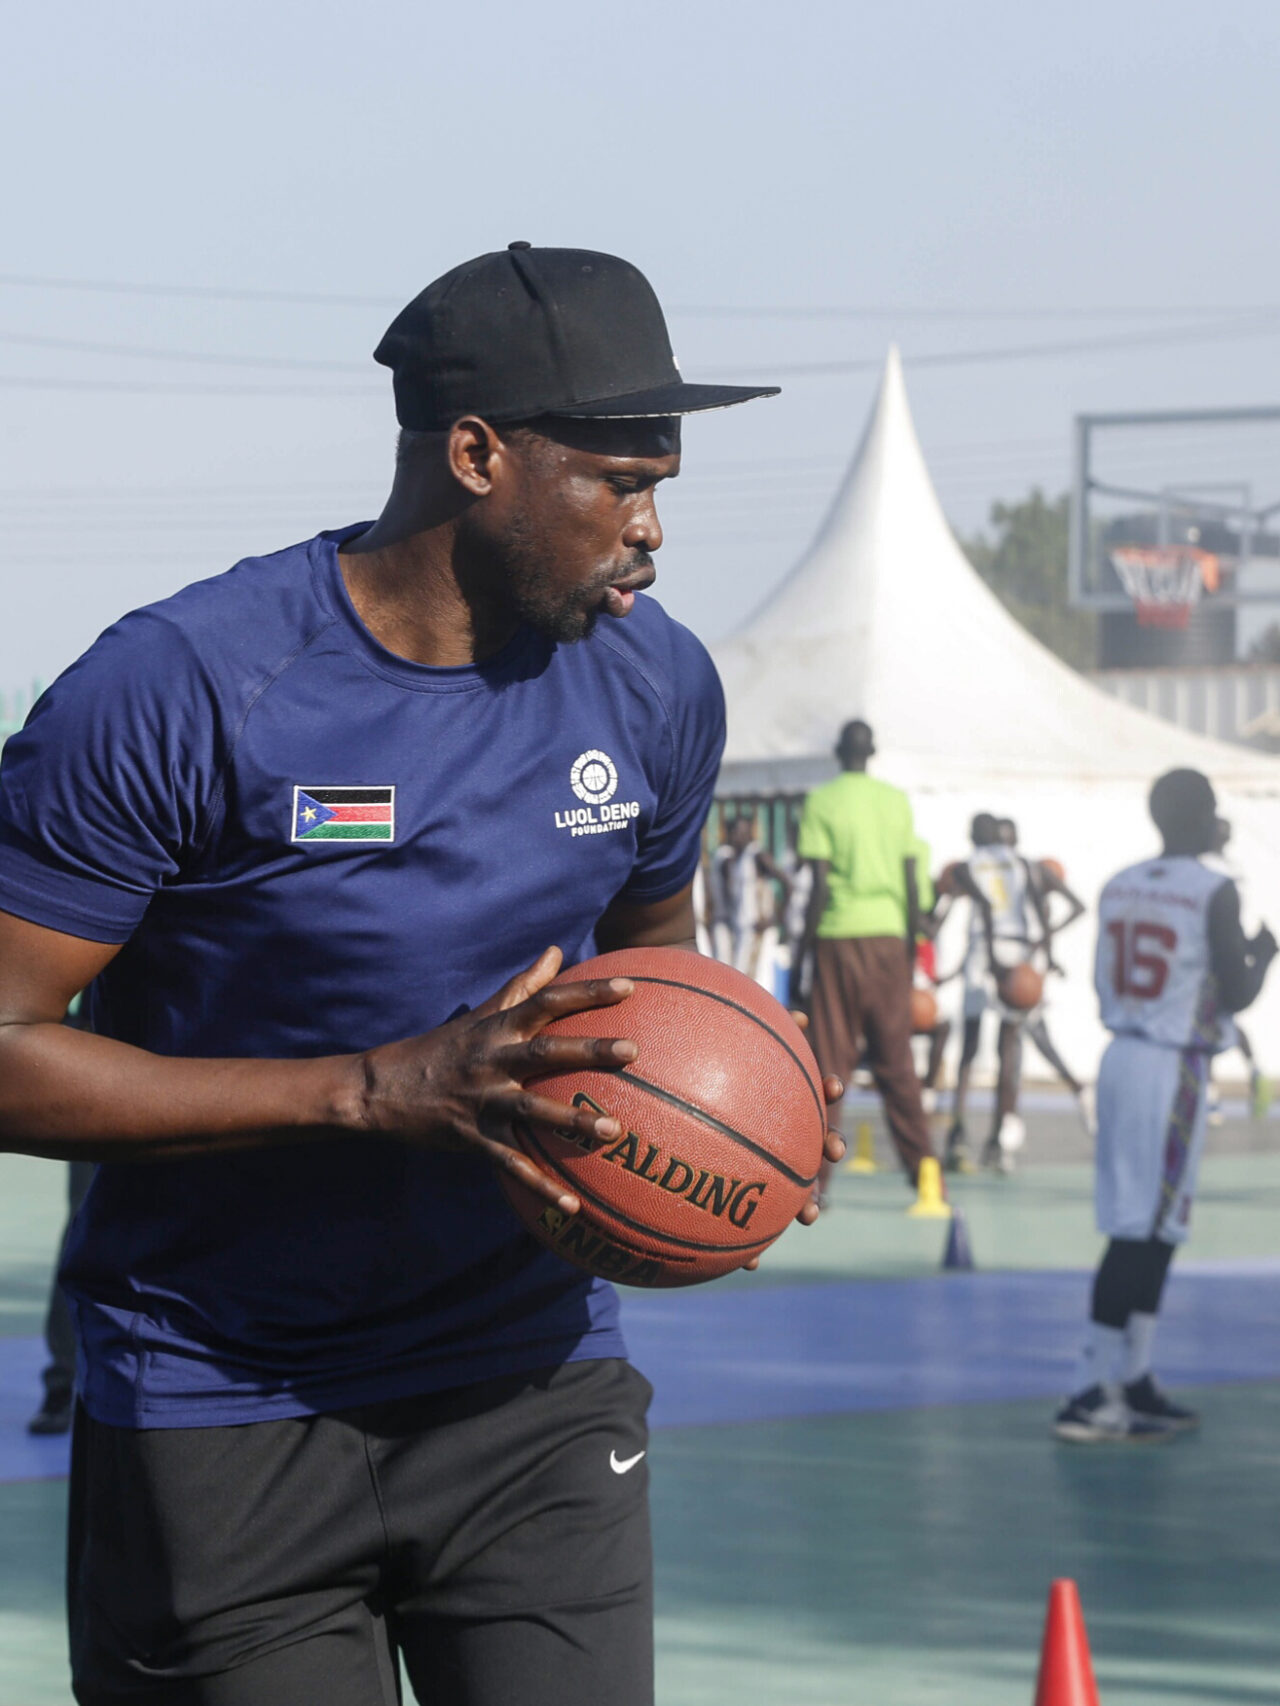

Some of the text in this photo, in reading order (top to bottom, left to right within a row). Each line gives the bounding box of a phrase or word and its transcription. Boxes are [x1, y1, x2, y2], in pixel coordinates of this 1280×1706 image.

[555, 801, 640, 828] LUOL DENG
[571, 820, 629, 838] FOUNDATION
[557, 1221, 664, 1284] NBA
